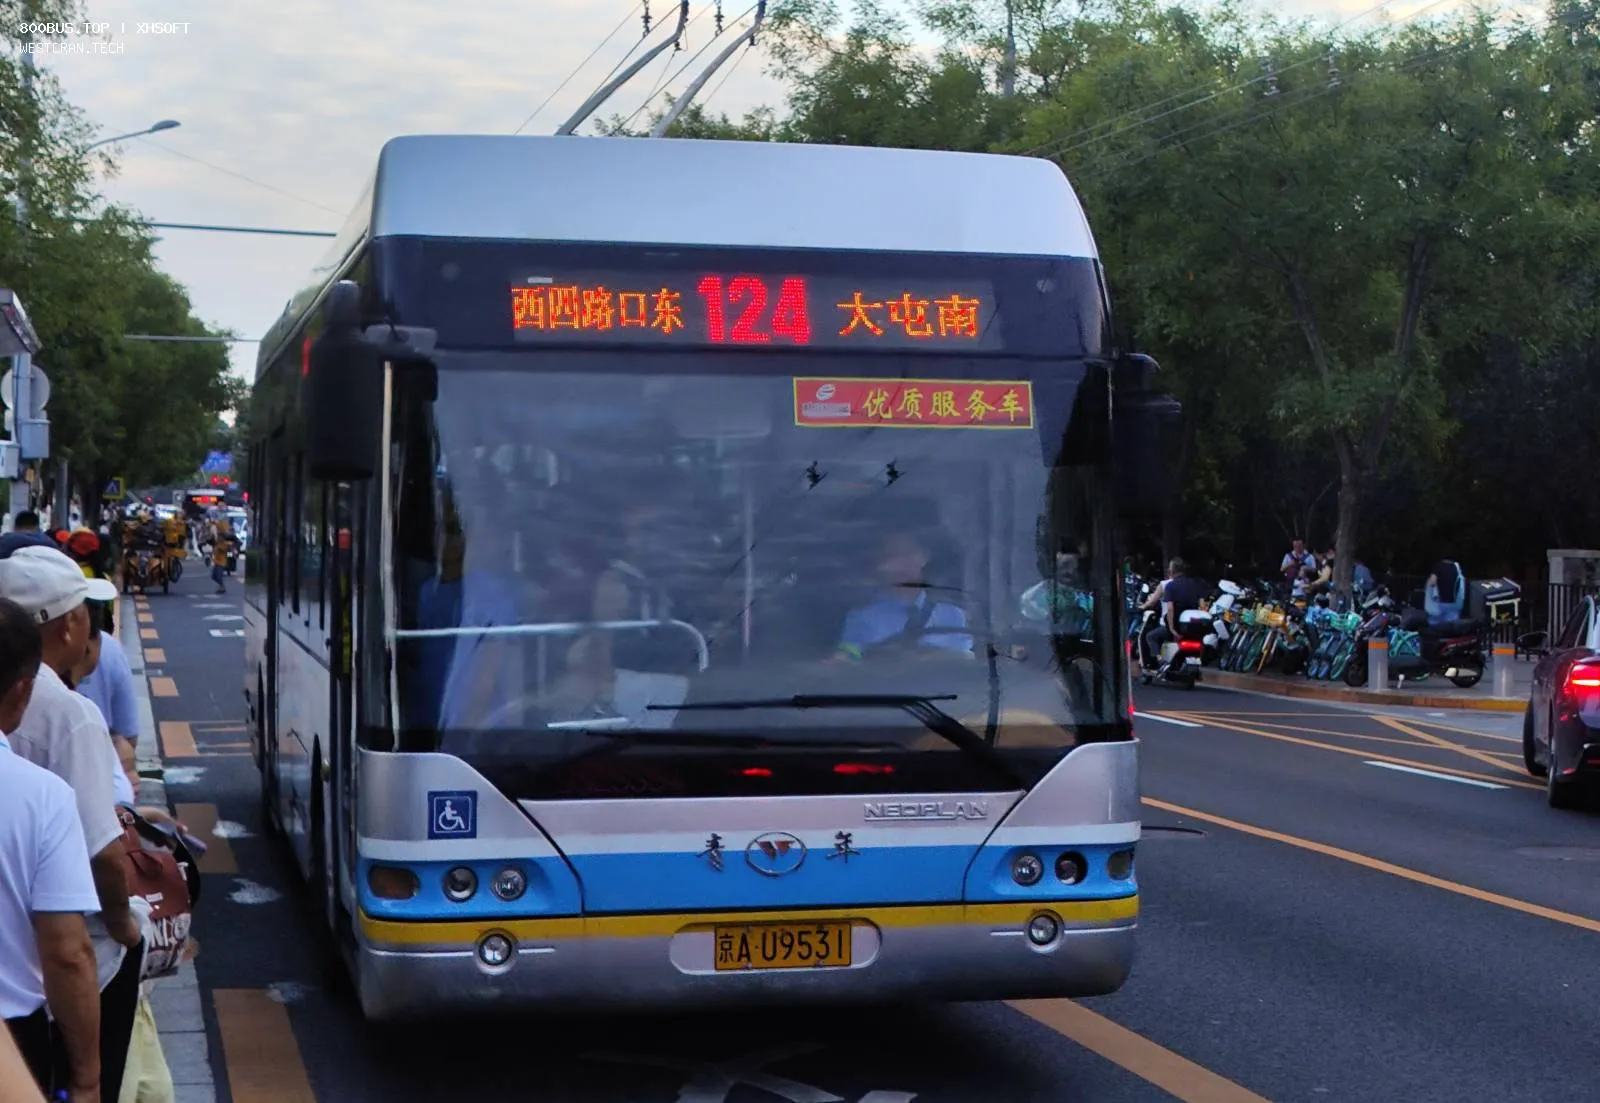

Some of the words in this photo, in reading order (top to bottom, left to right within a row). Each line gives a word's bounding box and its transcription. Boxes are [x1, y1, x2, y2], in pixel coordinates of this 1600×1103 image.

[511, 285, 684, 334] 西四路口东
[698, 275, 811, 345] 124
[836, 292, 981, 338] 大屯南
[863, 387, 1025, 422] 优质服务车
[863, 801, 989, 821] NEOPLAN
